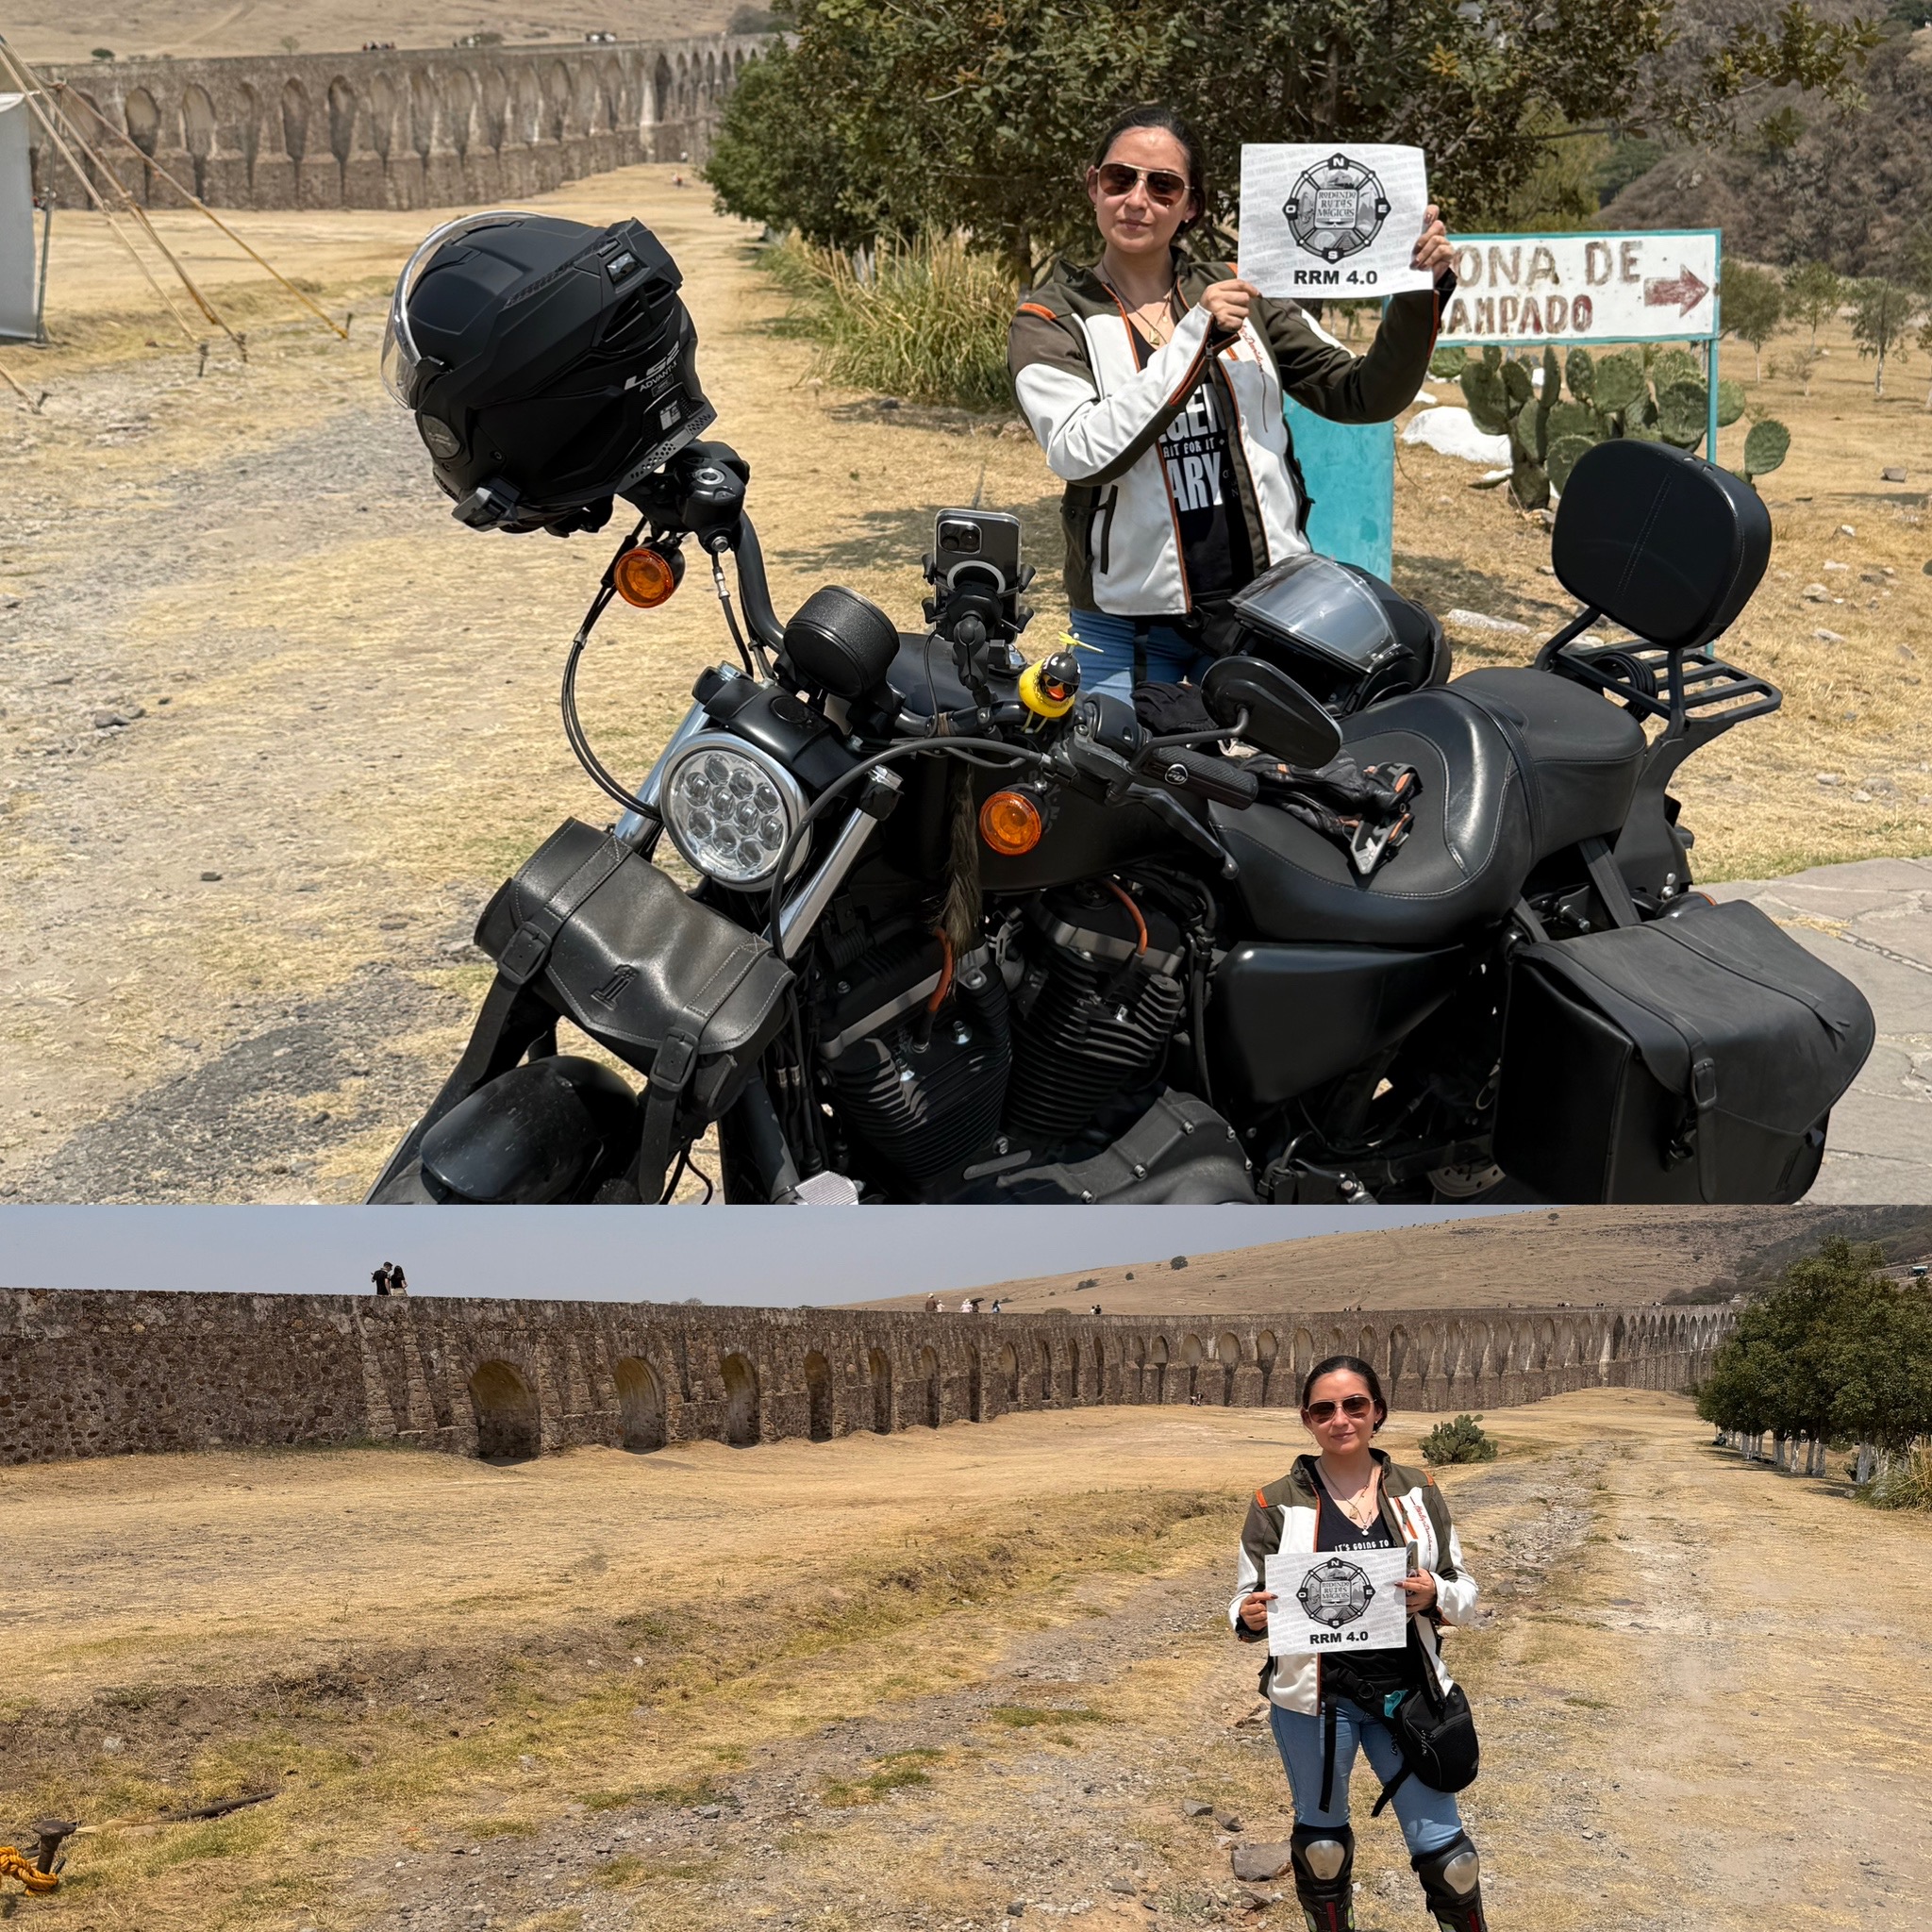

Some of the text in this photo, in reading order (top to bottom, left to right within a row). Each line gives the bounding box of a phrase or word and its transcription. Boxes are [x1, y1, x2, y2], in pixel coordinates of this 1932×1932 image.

[1332, 157, 1345, 168] N
[1377, 205, 1388, 213] E
[1327, 250, 1339, 259] S
[1453, 240, 1643, 289] ONA DE
[1293, 270, 1378, 285] RRM 4.0
[1439, 294, 1593, 335] AMPADO
[624, 340, 680, 391] LS2
[1158, 382, 1227, 443] GEN
[1163, 437, 1216, 458] AIT FOR IT
[1166, 451, 1224, 512] ARY
[1335, 1543, 1350, 1553] IT'S
[1353, 1541, 1377, 1551] GOING
[1379, 1539, 1390, 1548] TO
[1309, 1631, 1369, 1645] RRM 4.0
